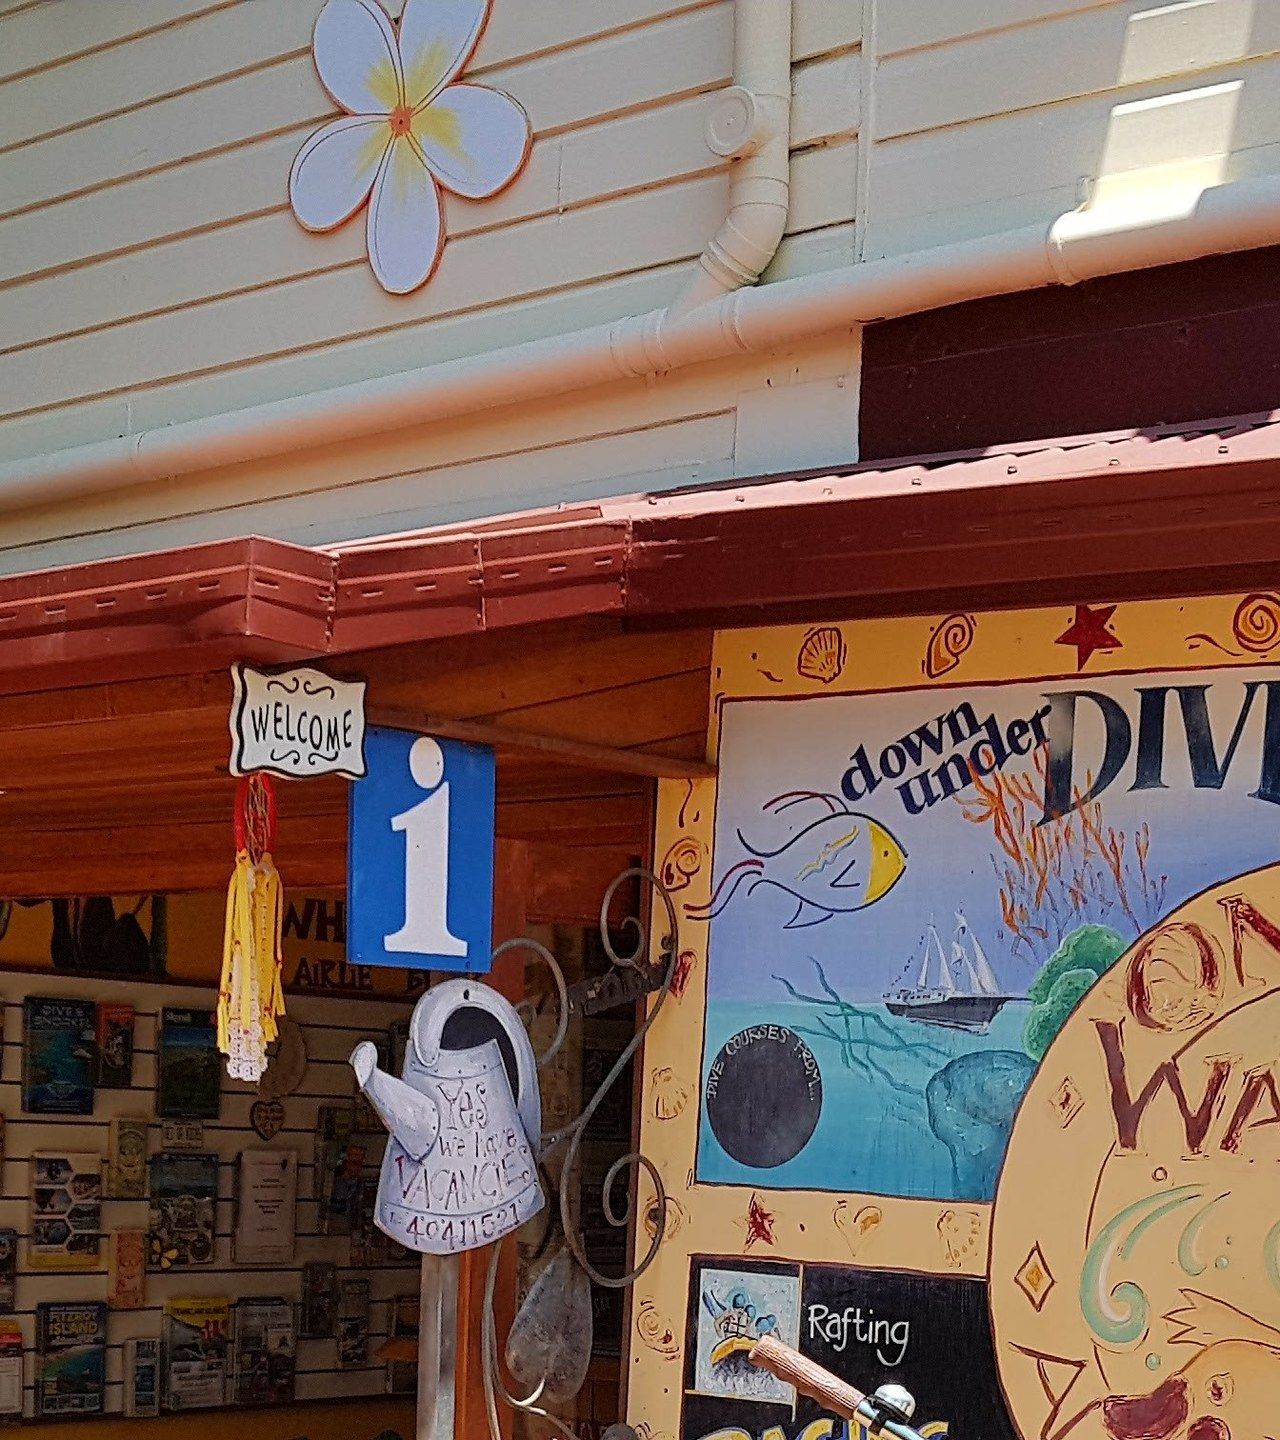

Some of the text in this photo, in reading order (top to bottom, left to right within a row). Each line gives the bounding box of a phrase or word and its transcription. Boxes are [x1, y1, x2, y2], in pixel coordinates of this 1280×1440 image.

[251, 701, 352, 752] WELCOME
[840, 701, 983, 801] down
[894, 704, 1052, 815] under
[706, 1060, 725, 1099] DIVE
[725, 1025, 790, 1056] COURSES
[435, 1078, 489, 1131] Yes
[439, 1126, 518, 1158] we have
[807, 1304, 910, 1366] Rafting
